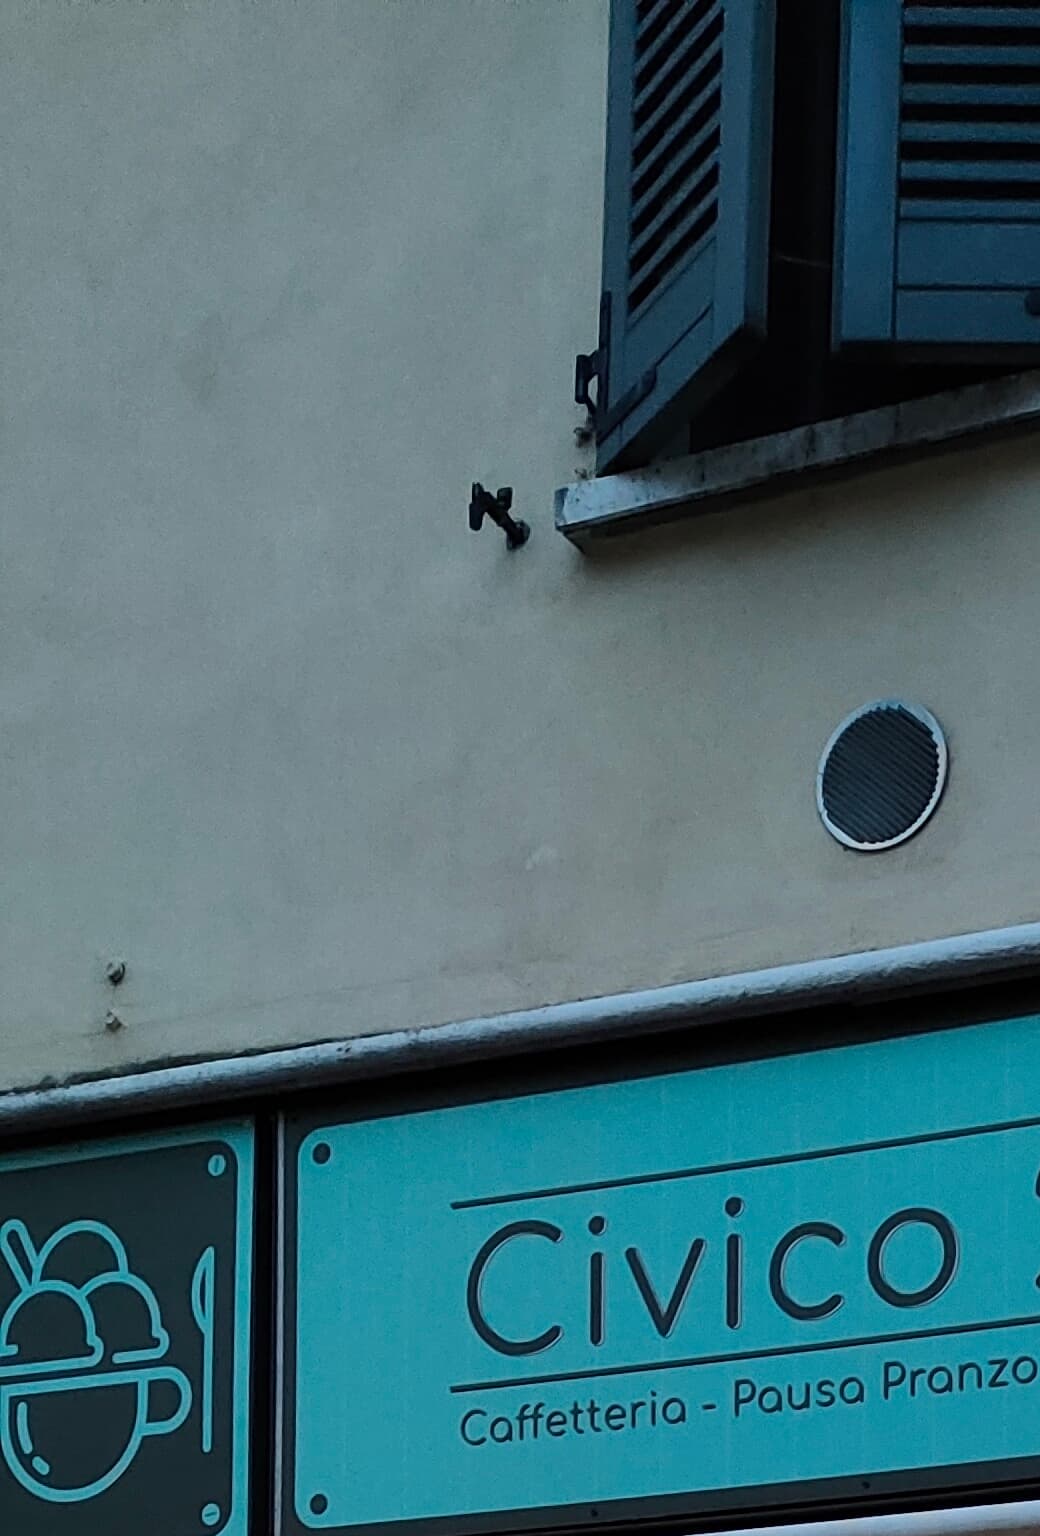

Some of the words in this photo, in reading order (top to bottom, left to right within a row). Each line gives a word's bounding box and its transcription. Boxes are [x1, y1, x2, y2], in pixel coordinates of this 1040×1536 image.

[466, 1196, 960, 1356] Civico
[460, 1391, 688, 1447] Caffetteria
[734, 1376, 866, 1418] Pausa
[882, 1353, 1039, 1400] Pranzo
